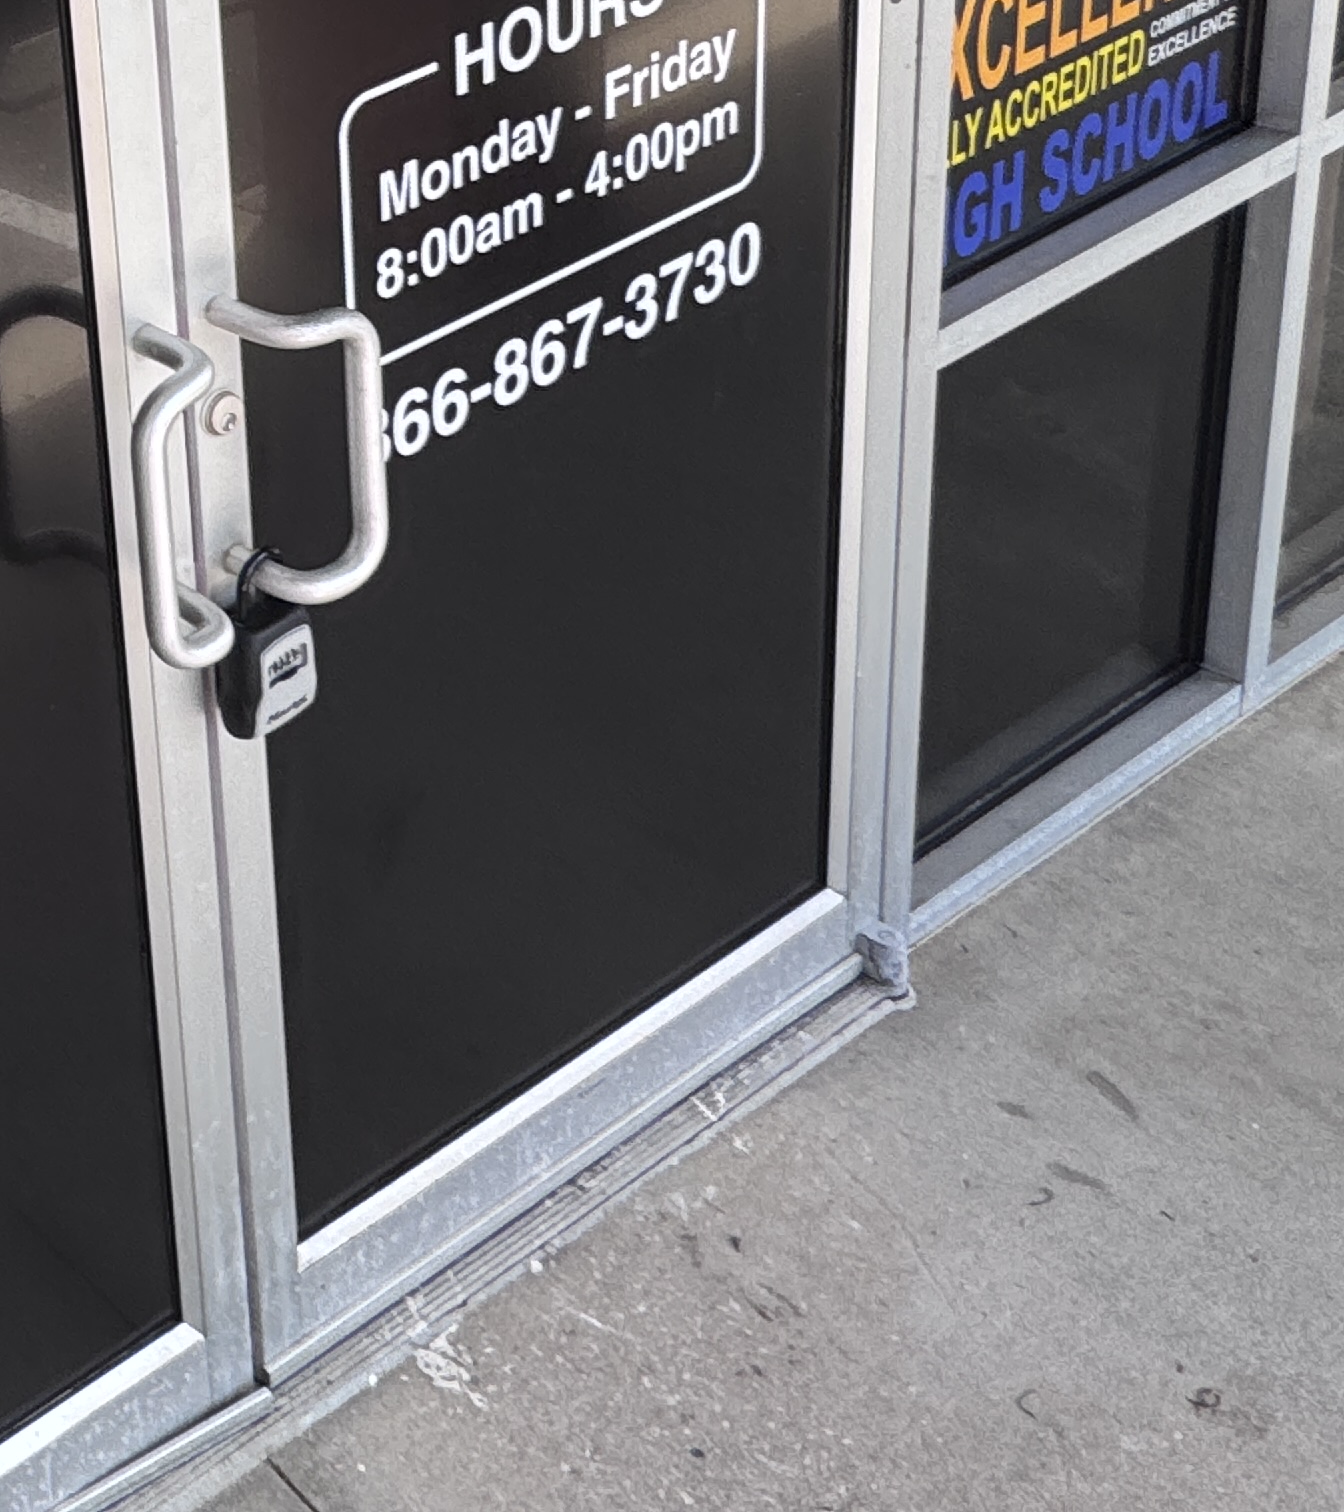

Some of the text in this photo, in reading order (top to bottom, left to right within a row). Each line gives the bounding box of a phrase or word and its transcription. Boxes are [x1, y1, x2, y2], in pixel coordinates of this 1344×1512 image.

[378, 29, 737, 222] Monday - Friday
[944, 50, 1228, 266] GH SCHOOL
[984, 29, 1146, 150] ACCREDITED
[375, 101, 740, 299] 8:00am - 4:00pm
